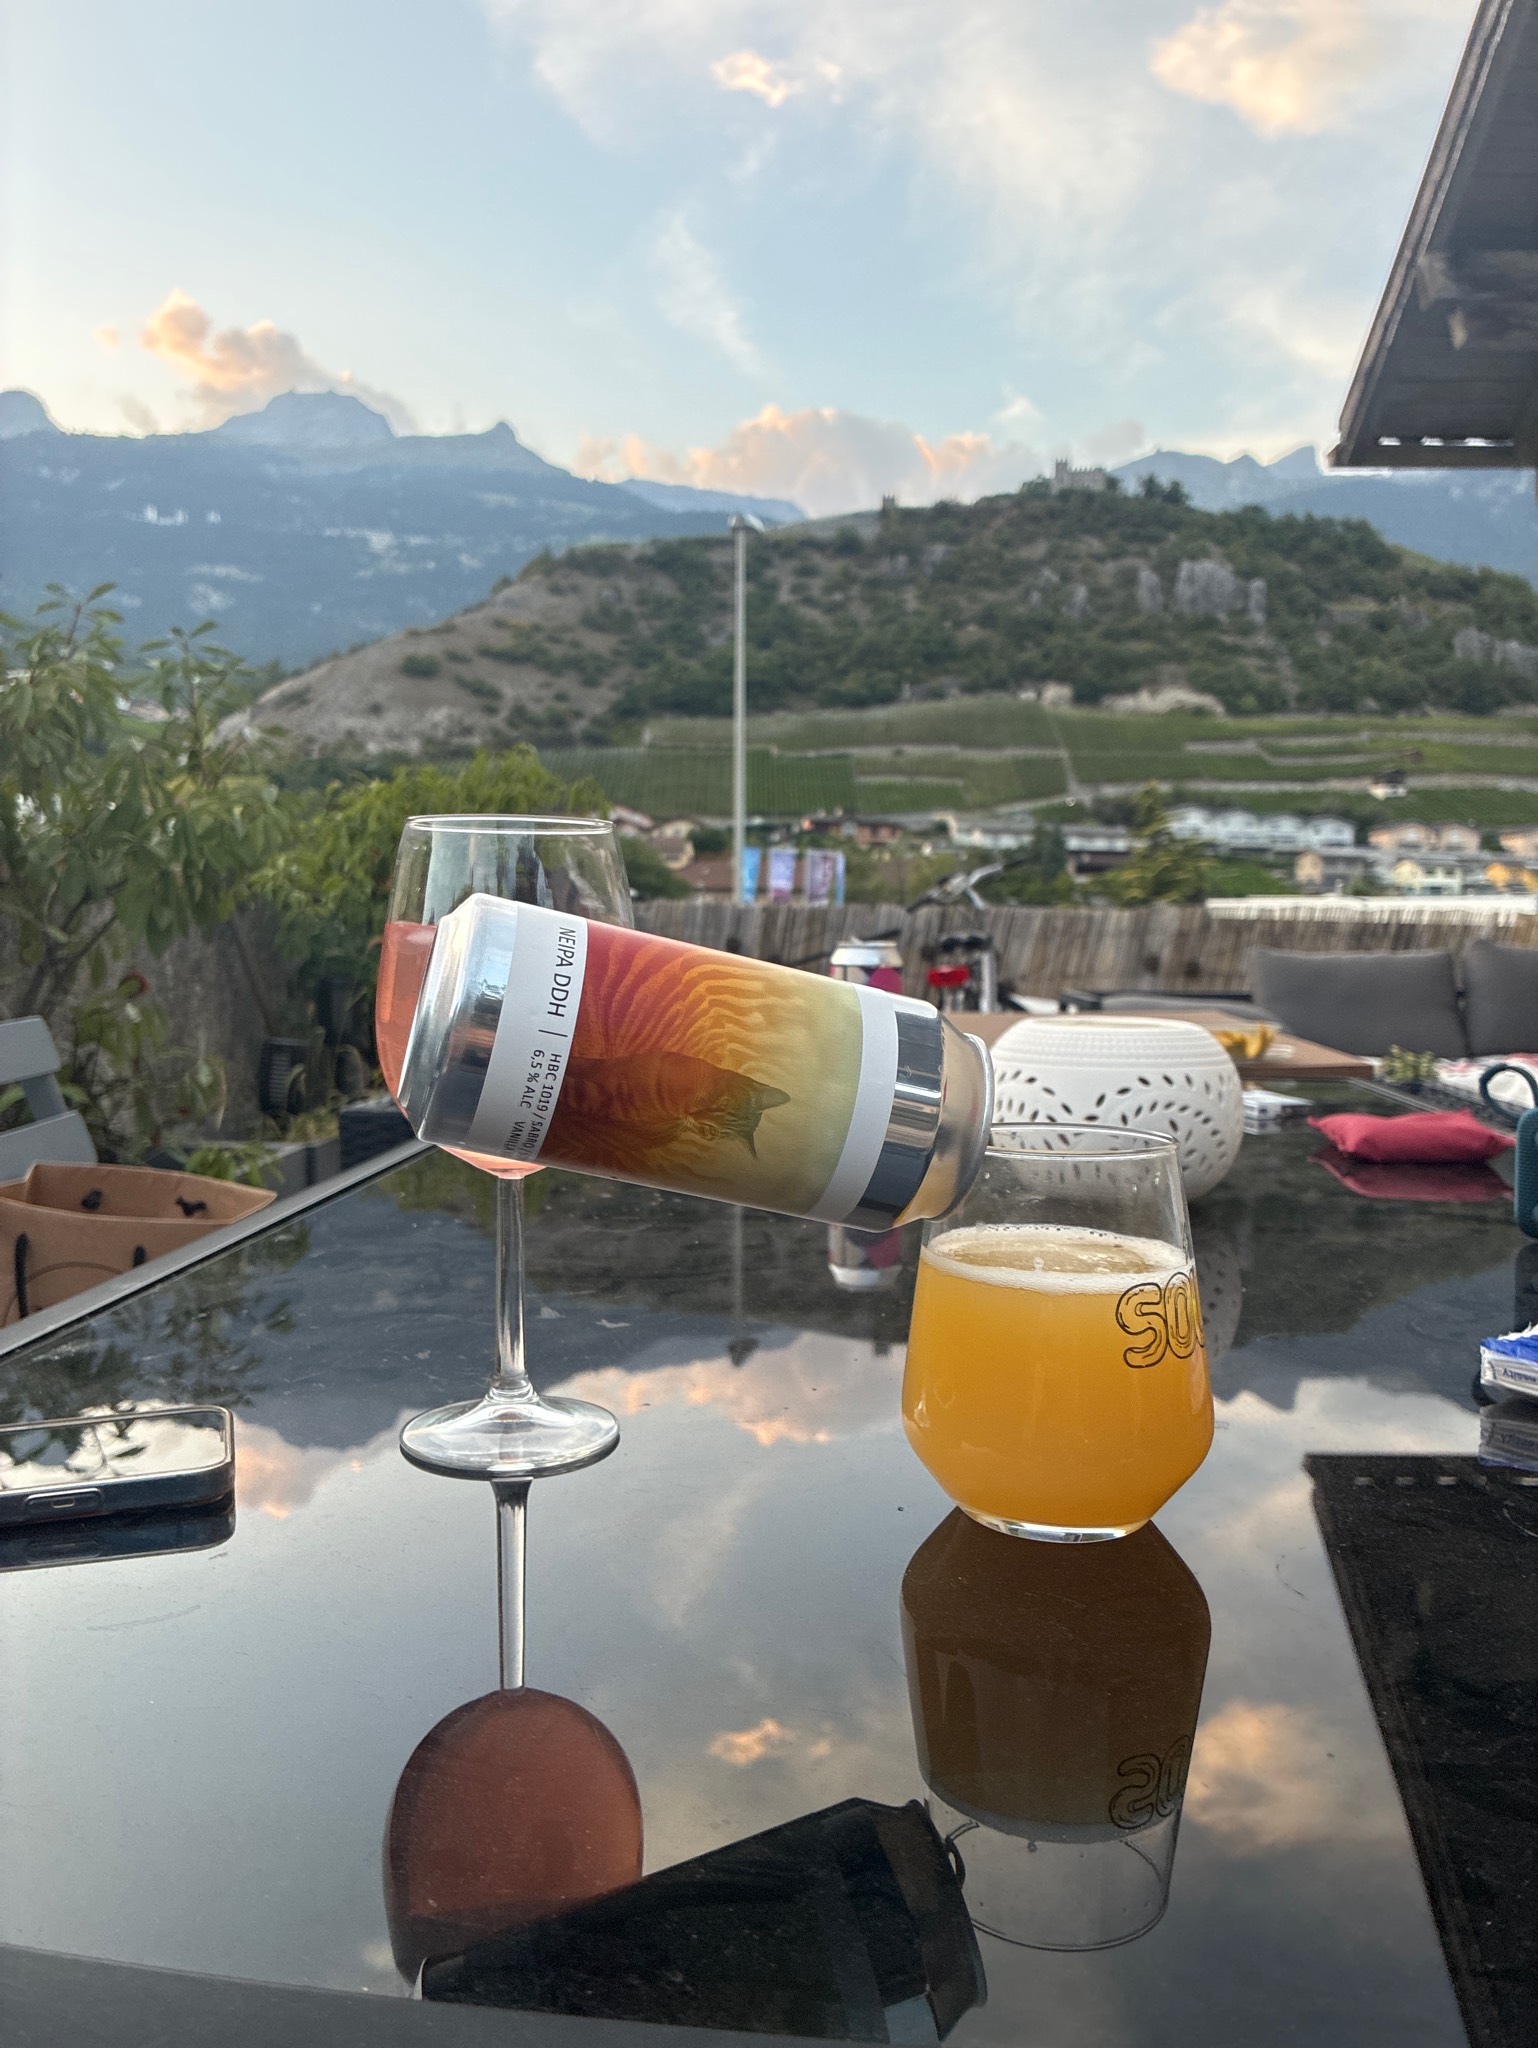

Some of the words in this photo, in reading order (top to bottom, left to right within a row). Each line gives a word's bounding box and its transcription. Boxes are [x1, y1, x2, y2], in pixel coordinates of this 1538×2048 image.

[555, 926, 576, 968] NEIPA
[547, 973, 572, 1018] DDH
[530, 1049, 545, 1070] 6,5
[544, 1053, 562, 1082] HBC
[520, 1085, 536, 1109] ALC
[536, 1084, 554, 1113] 1019
